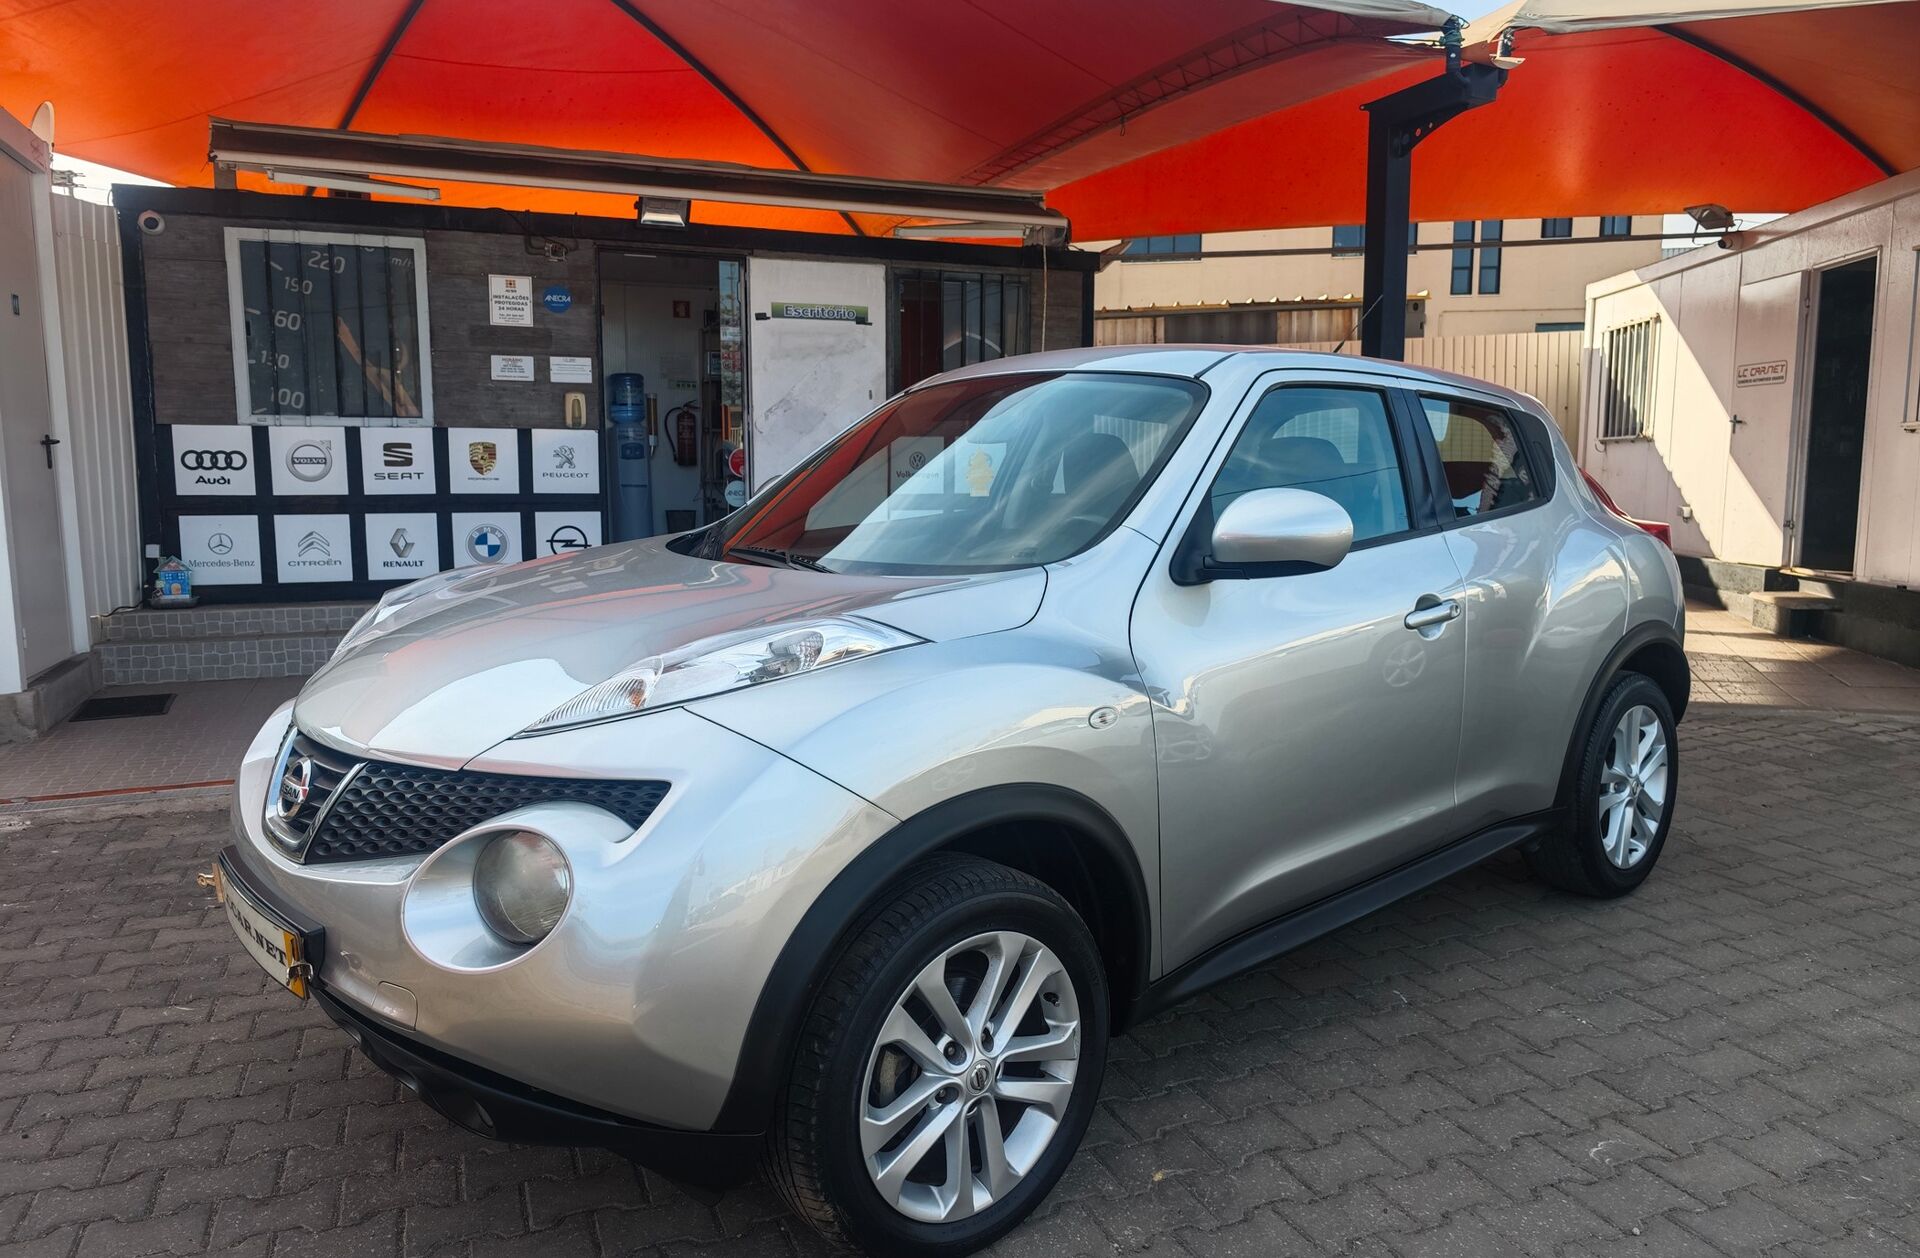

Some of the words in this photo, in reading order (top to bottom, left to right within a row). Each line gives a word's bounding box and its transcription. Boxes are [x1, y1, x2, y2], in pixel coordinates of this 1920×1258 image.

[308, 251, 346, 274] 220
[784, 304, 856, 319] Escritório
[195, 475, 231, 485] Audi
[374, 472, 424, 480] SEAT
[472, 526, 503, 538] BMW
[188, 559, 255, 567] Mercedes-Benz
[383, 560, 424, 568] RENAULT
